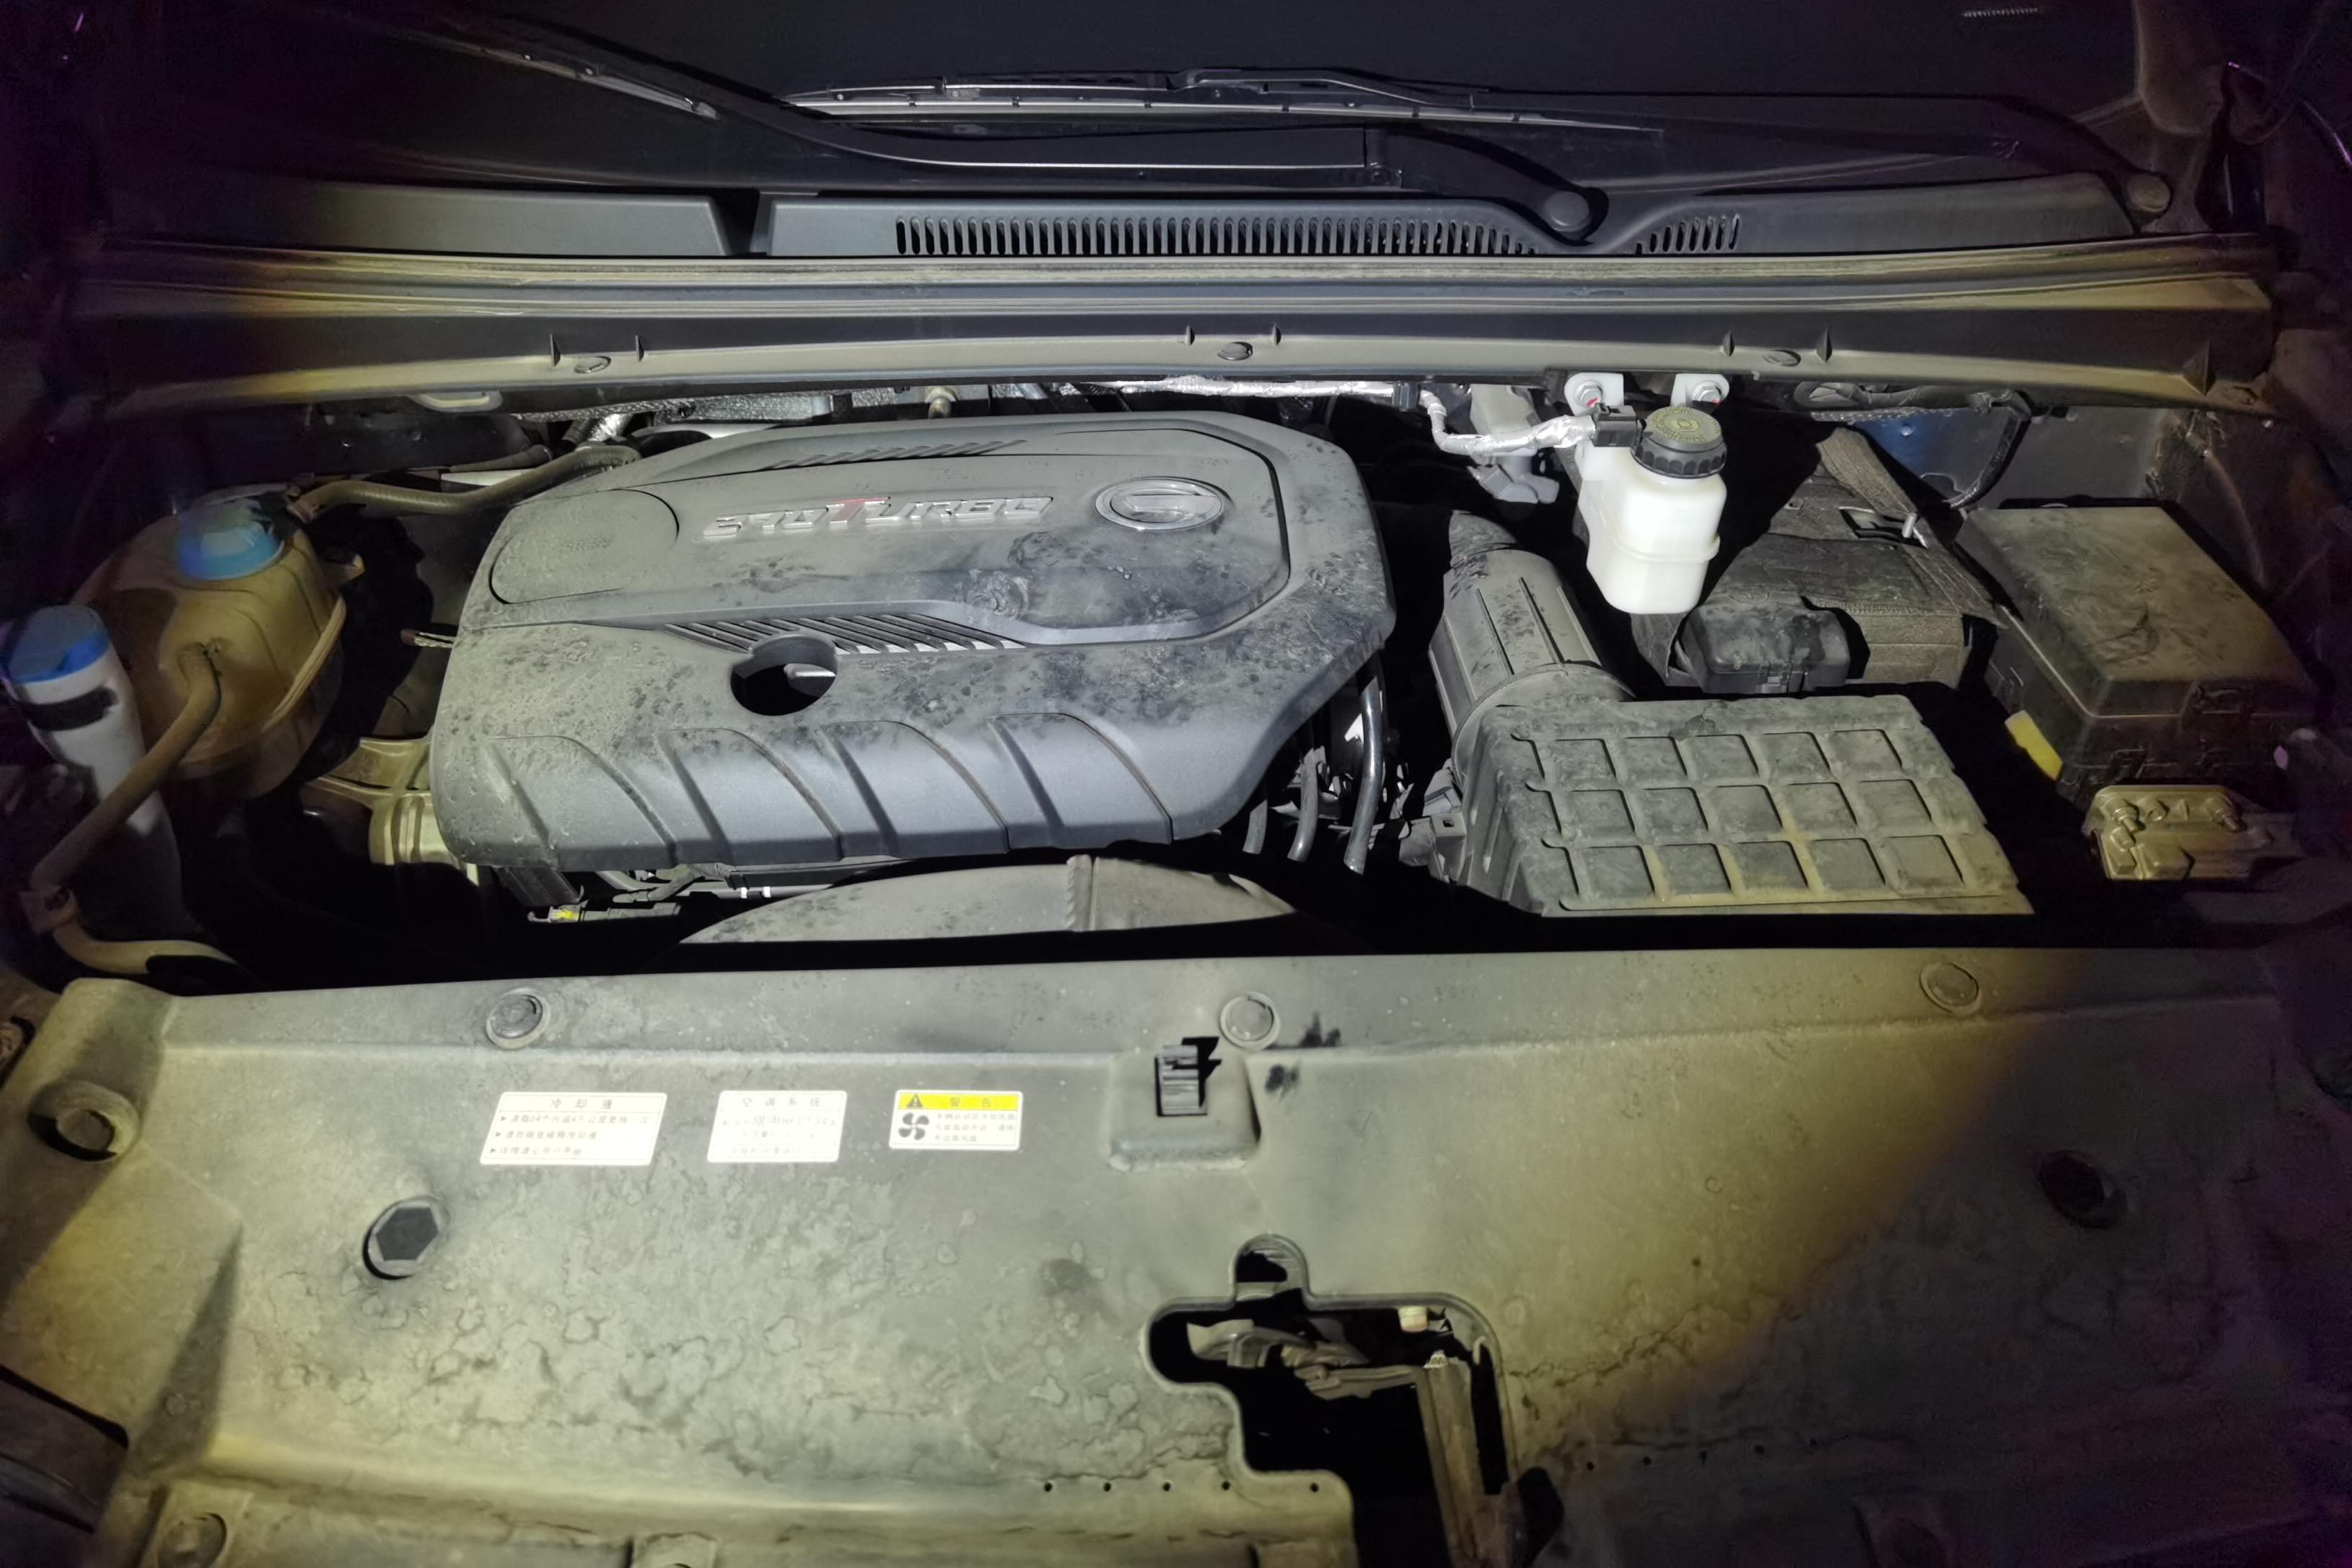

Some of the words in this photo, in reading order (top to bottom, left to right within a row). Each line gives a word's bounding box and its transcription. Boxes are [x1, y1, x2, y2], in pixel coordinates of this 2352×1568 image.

[550, 1098, 612, 1109] 冷却液
[742, 1097, 820, 1107] 空调系统
[950, 1097, 992, 1107] 警告
